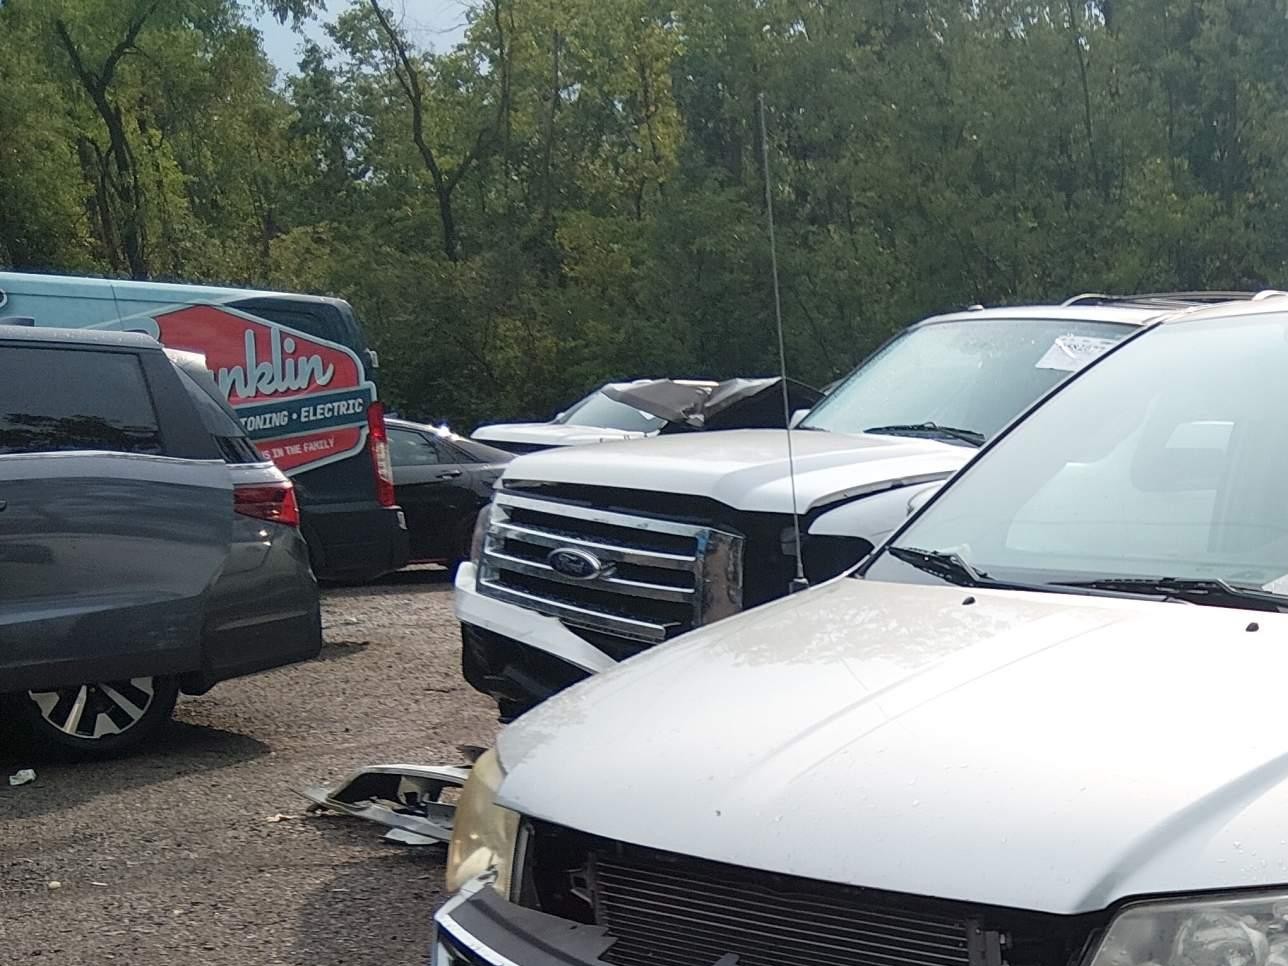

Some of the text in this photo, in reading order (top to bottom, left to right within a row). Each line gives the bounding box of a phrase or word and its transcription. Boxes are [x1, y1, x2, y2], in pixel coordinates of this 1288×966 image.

[209, 327, 334, 401] nklin
[301, 398, 364, 423] ELECTRIC
[271, 447, 285, 458] IN
[286, 444, 302, 455] THE
[303, 437, 335, 453] FAMILY
